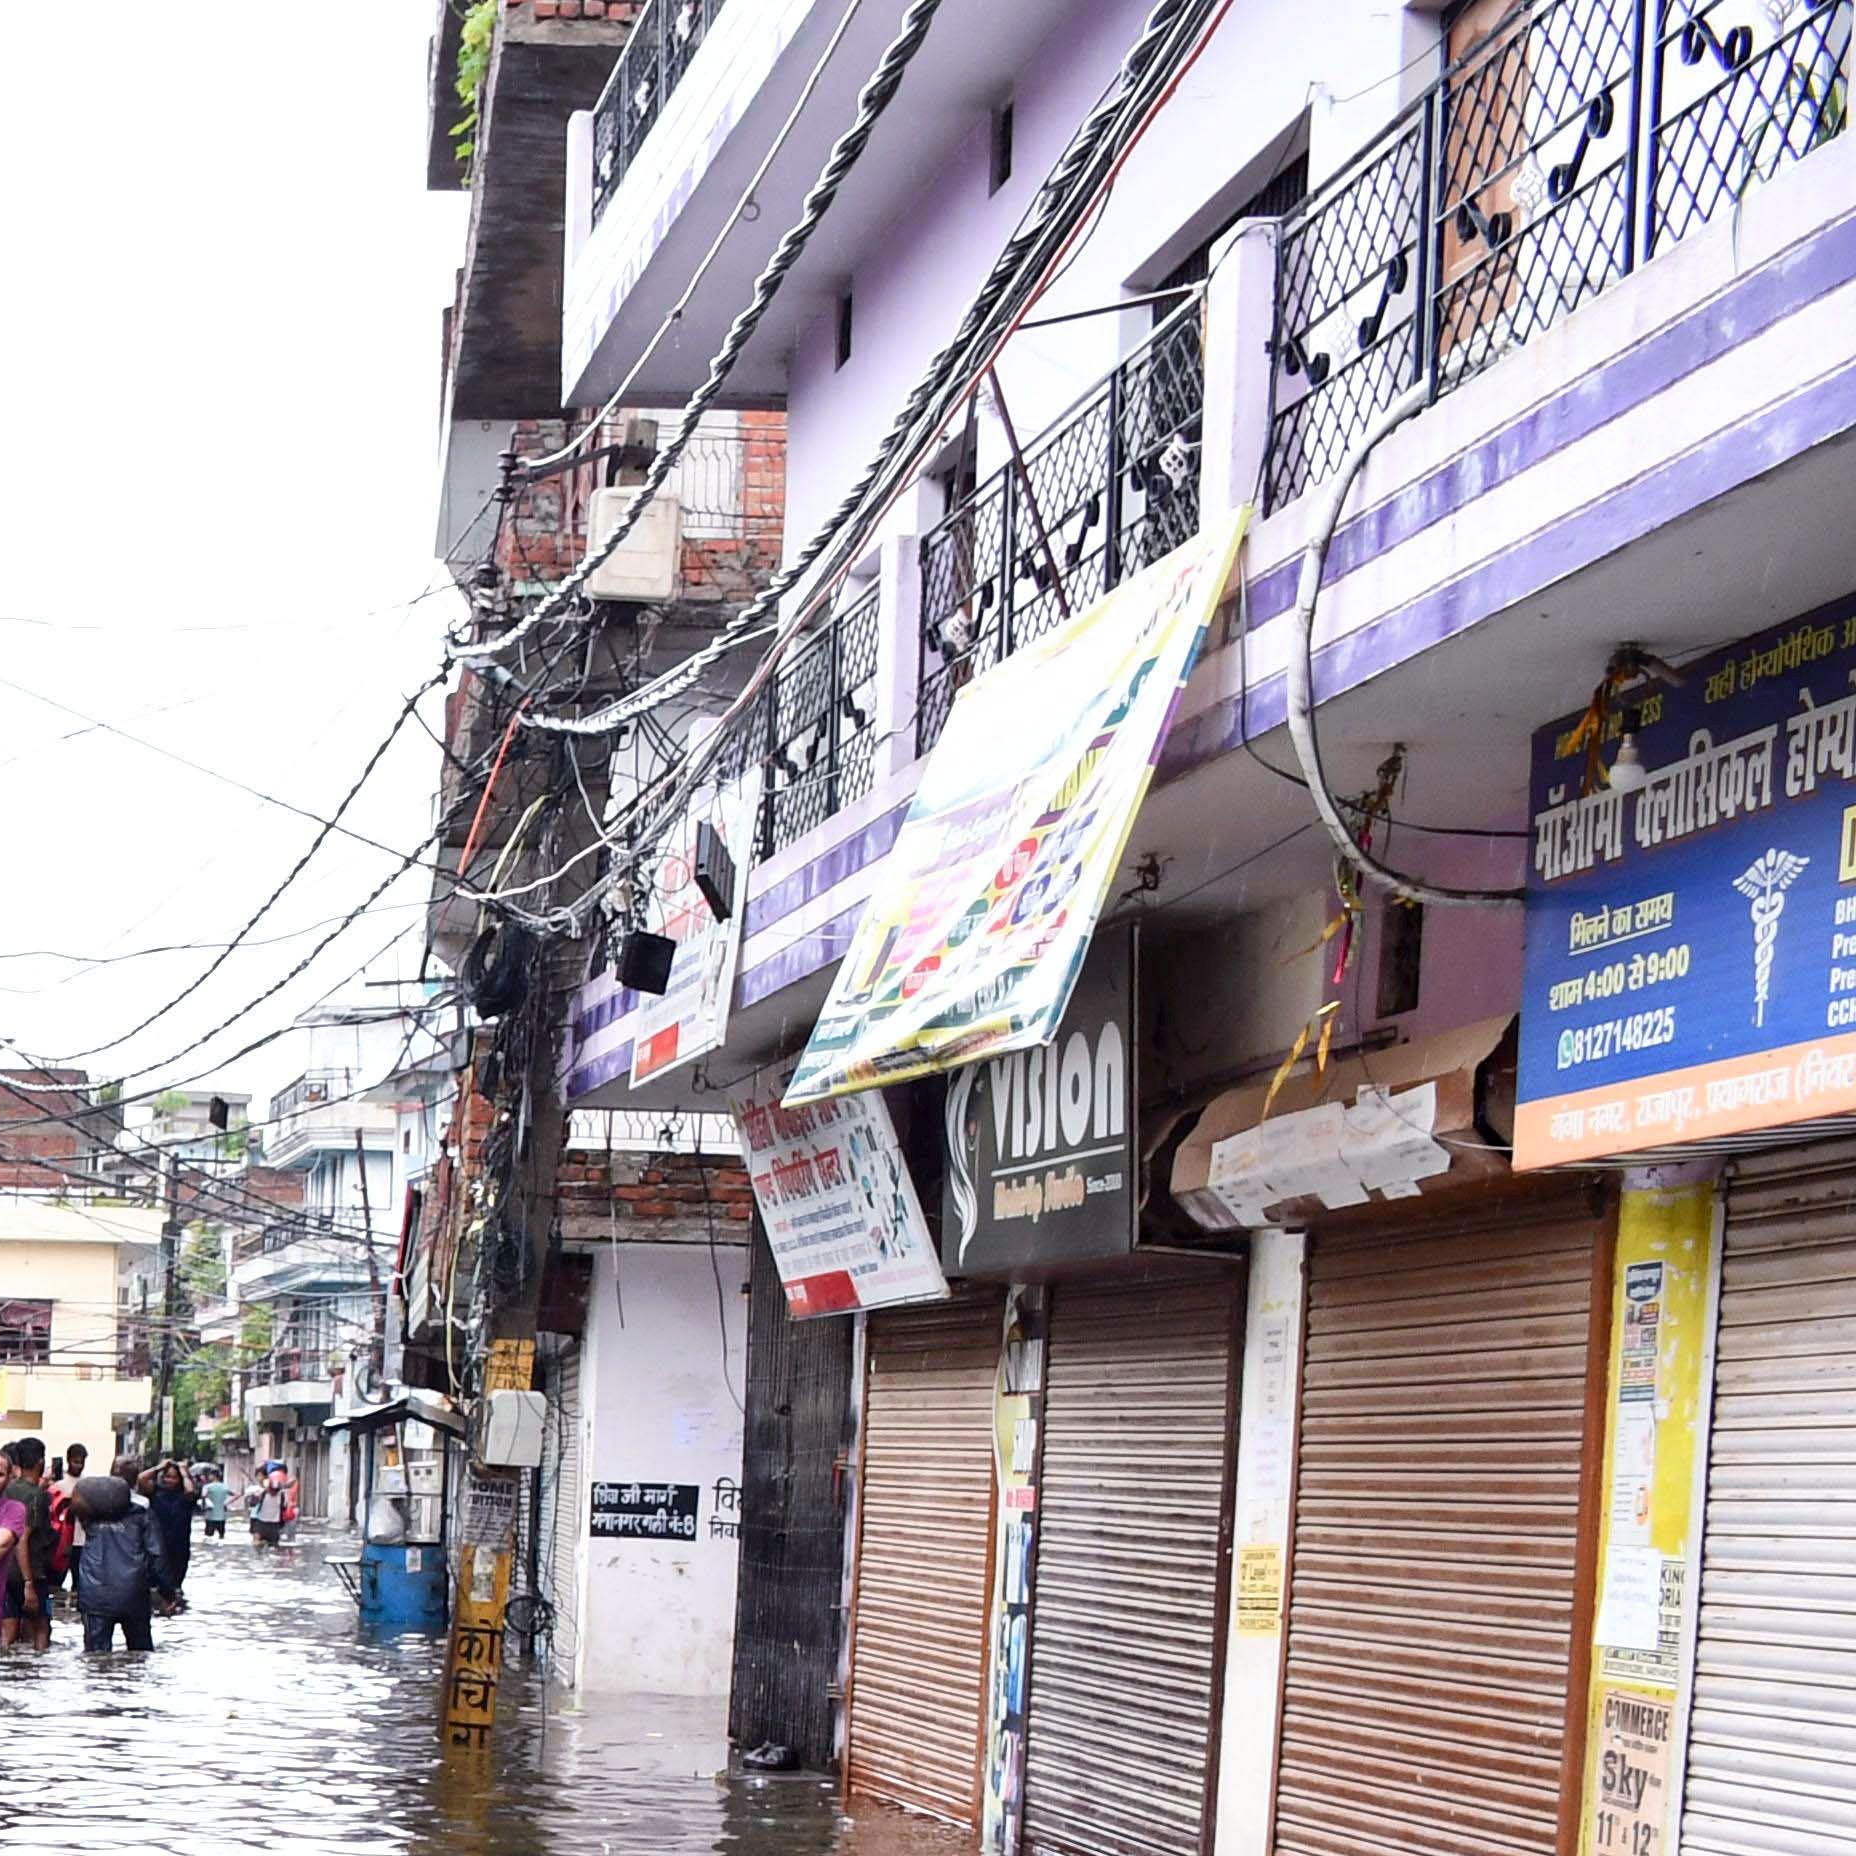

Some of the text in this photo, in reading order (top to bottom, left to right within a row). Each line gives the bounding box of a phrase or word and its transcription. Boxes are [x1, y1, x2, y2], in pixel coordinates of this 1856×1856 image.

[1612, 906, 1633, 935] का
[1635, 892, 1674, 929] समय
[1549, 944, 1690, 1012] शाम 4:00 से 9:00
[1574, 1006, 1676, 1064] 8127148225
[1604, 1698, 1670, 1742] COMMERCE
[1601, 1749, 1648, 1812] Sky
